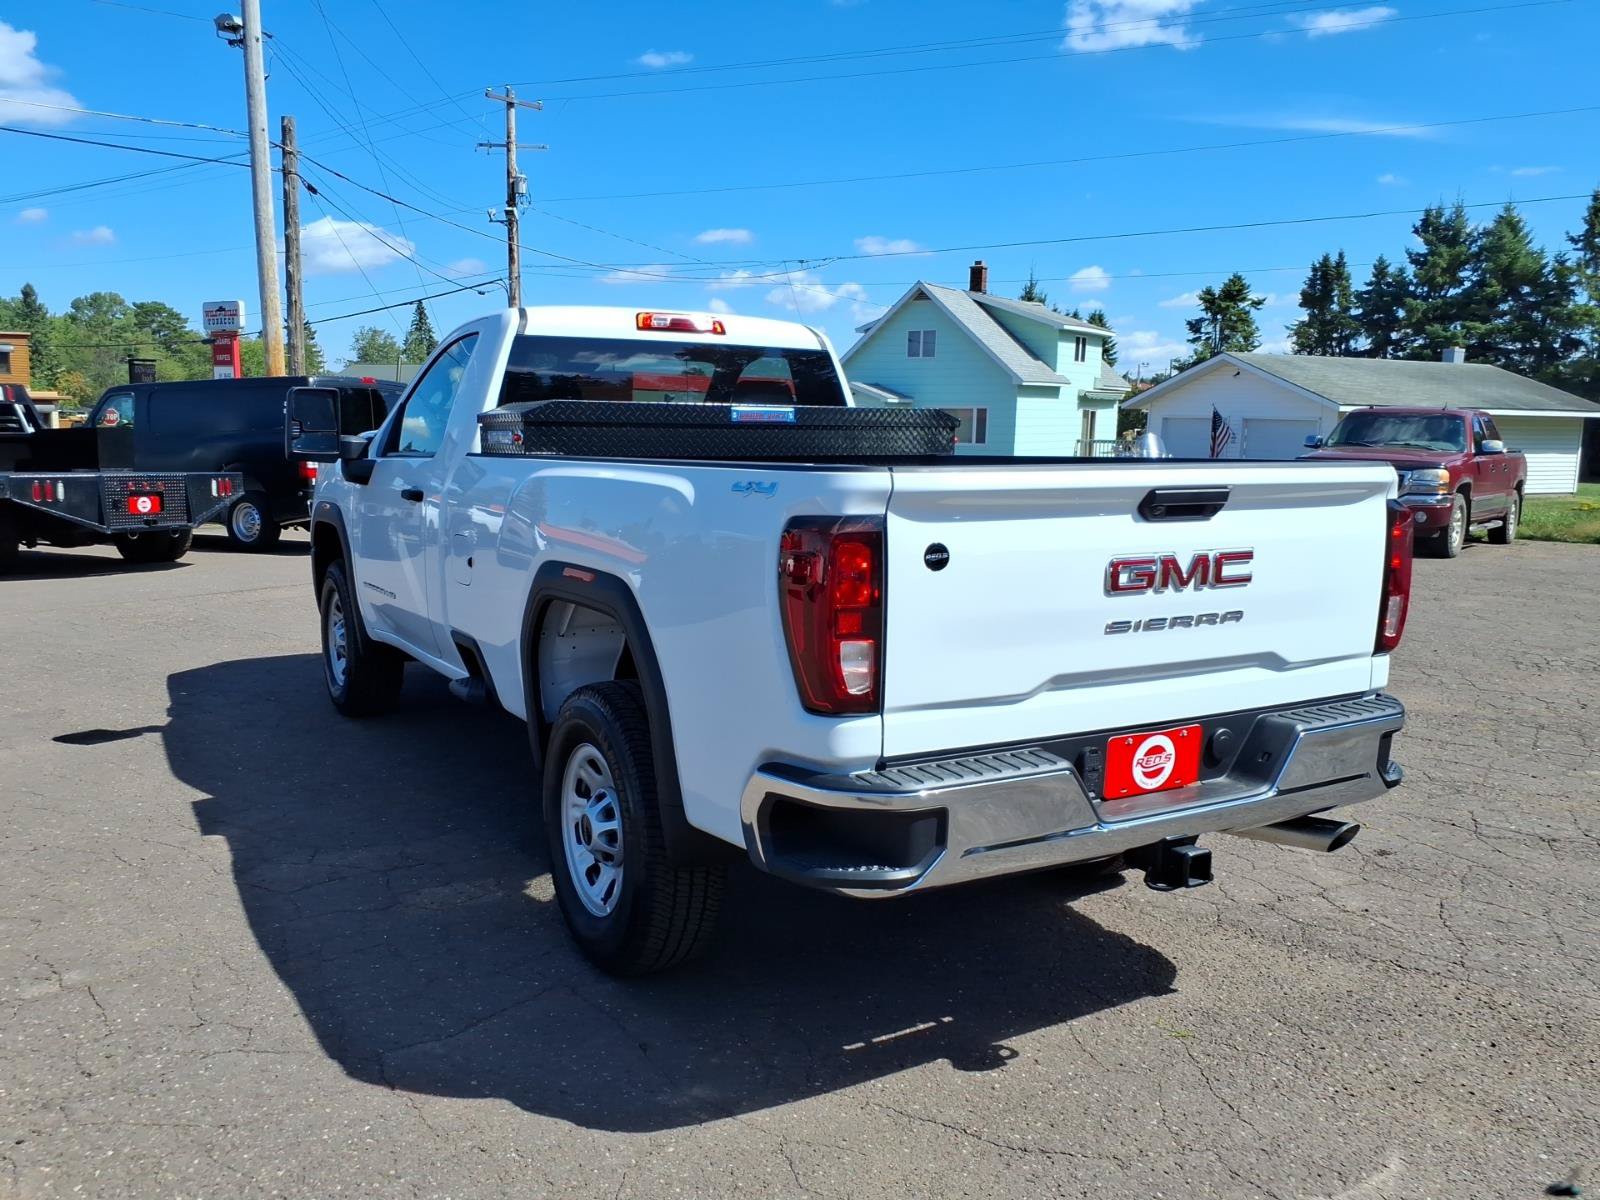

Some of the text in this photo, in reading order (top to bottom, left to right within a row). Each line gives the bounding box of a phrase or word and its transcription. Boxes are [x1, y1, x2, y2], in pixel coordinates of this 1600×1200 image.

[207, 317, 236, 325] TOBACCO
[1104, 548, 1254, 597] GMC
[1104, 610, 1244, 635] SIERRA
